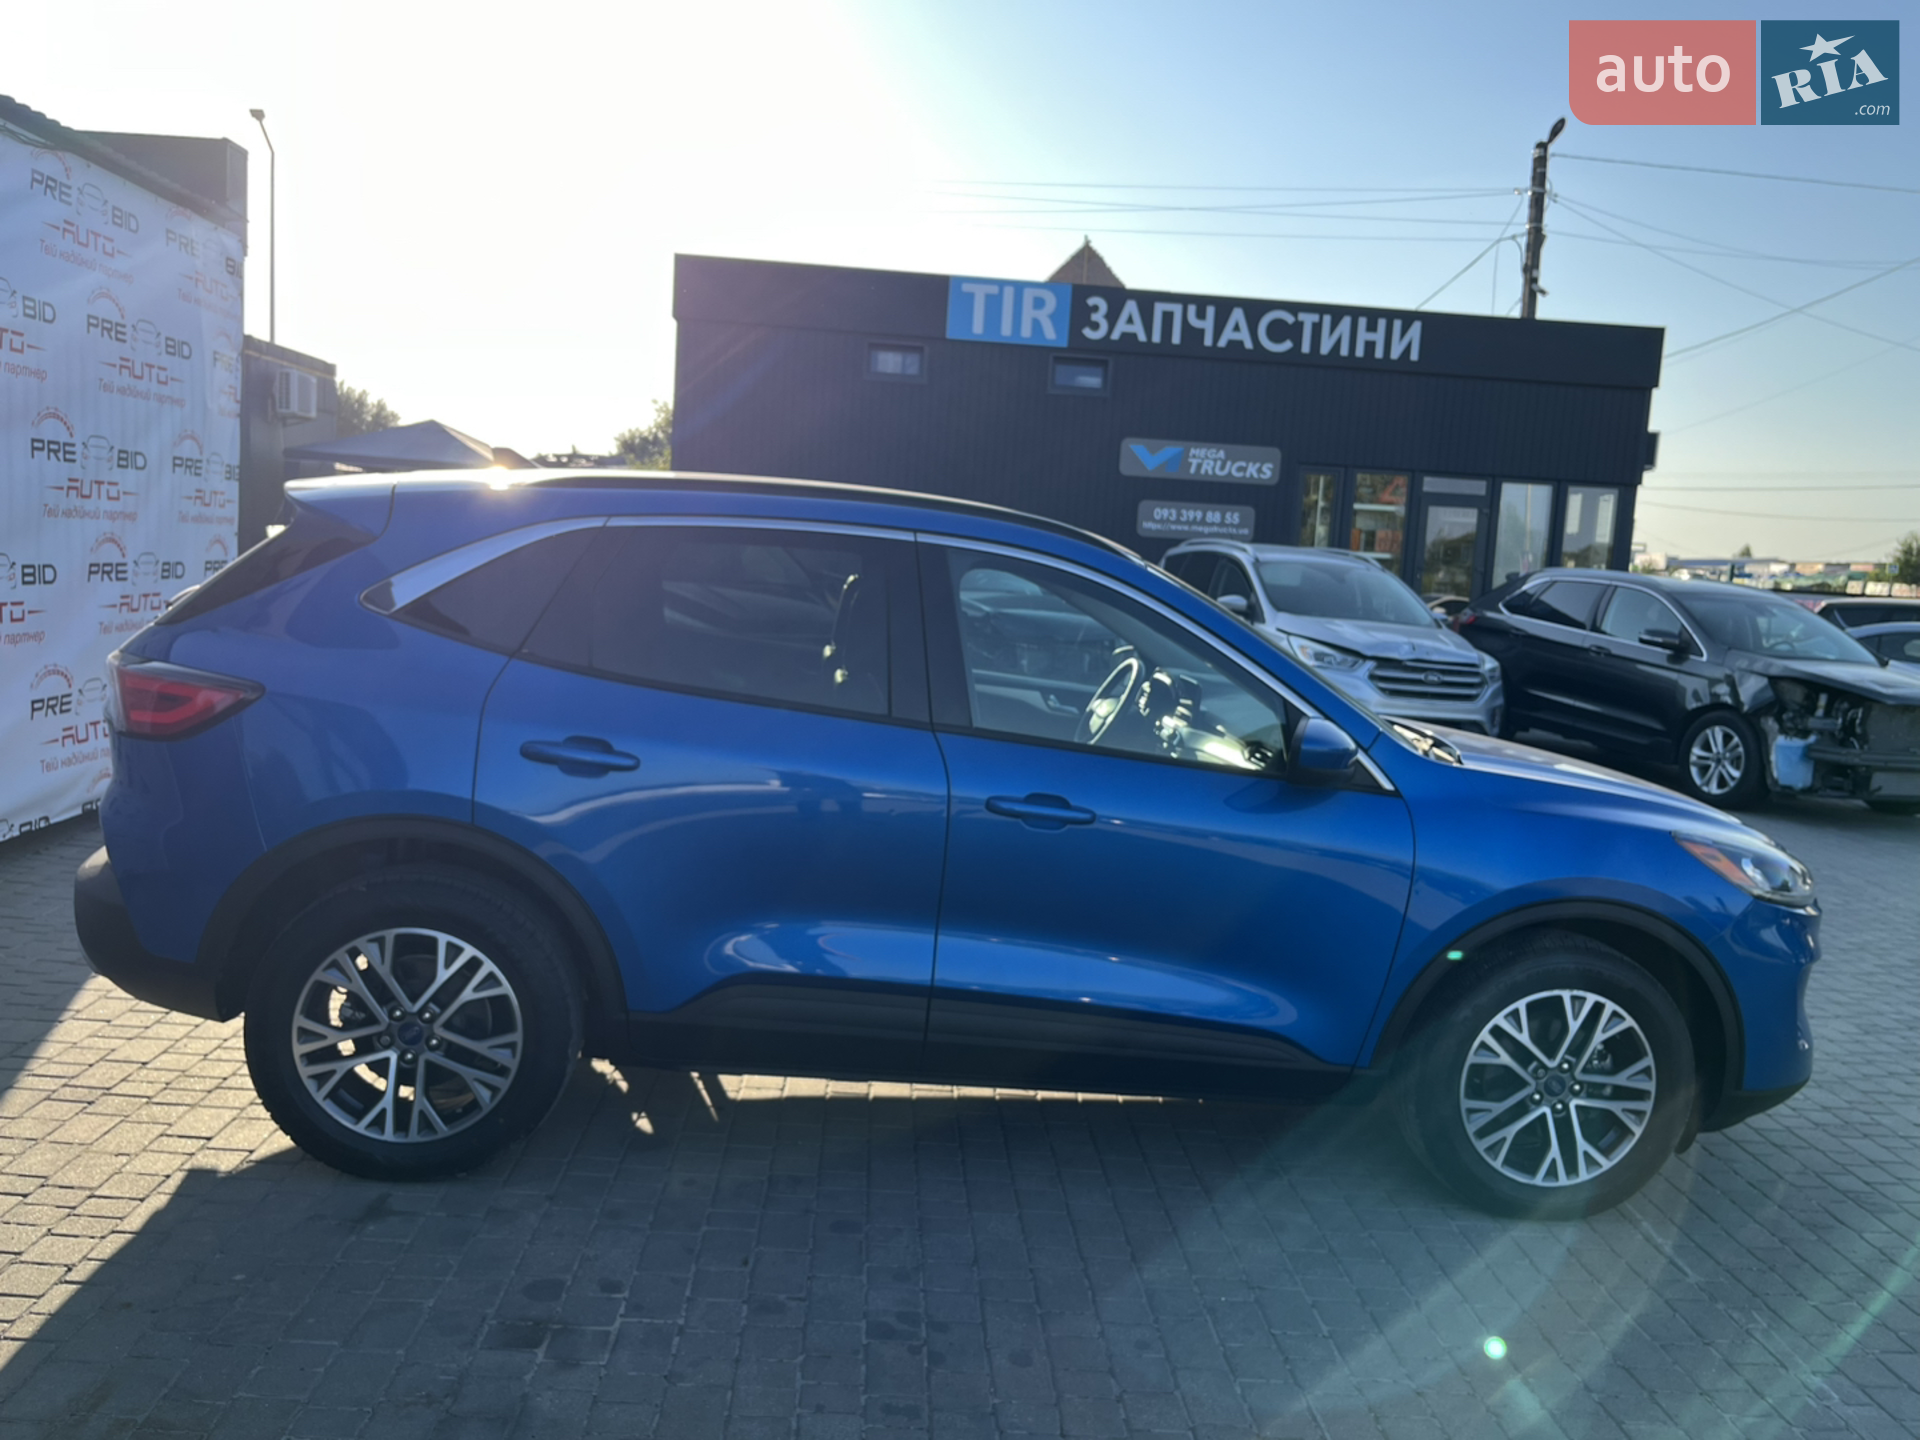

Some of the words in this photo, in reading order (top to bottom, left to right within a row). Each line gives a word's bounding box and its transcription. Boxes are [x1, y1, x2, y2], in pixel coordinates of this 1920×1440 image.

[30, 167, 73, 207] PRE
[111, 204, 139, 234] BID
[62, 218, 115, 259] AUTO
[165, 227, 199, 258] PRE
[22, 295, 56, 325] BID
[960, 282, 1058, 341] TIR
[86, 313, 128, 344] PRE
[164, 336, 193, 360] BID
[1081, 296, 1423, 363] ЗАПЧАСТИНИ
[119, 355, 168, 386] AUTO
[30, 437, 77, 464] PRE
[116, 448, 147, 471] BID
[172, 455, 203, 477] PRE
[1187, 457, 1274, 480] TRUCKS
[1188, 447, 1226, 460] MEGA
[66, 477, 120, 502] AUTO
[1153, 507, 1177, 521] 093
[1179, 508, 1203, 522] 399
[1205, 510, 1222, 524] 88
[1223, 511, 1241, 525] 55
[21, 563, 57, 586] BID
[87, 562, 129, 583] PRE
[160, 560, 186, 580] BID
[30, 692, 73, 721] PRE
